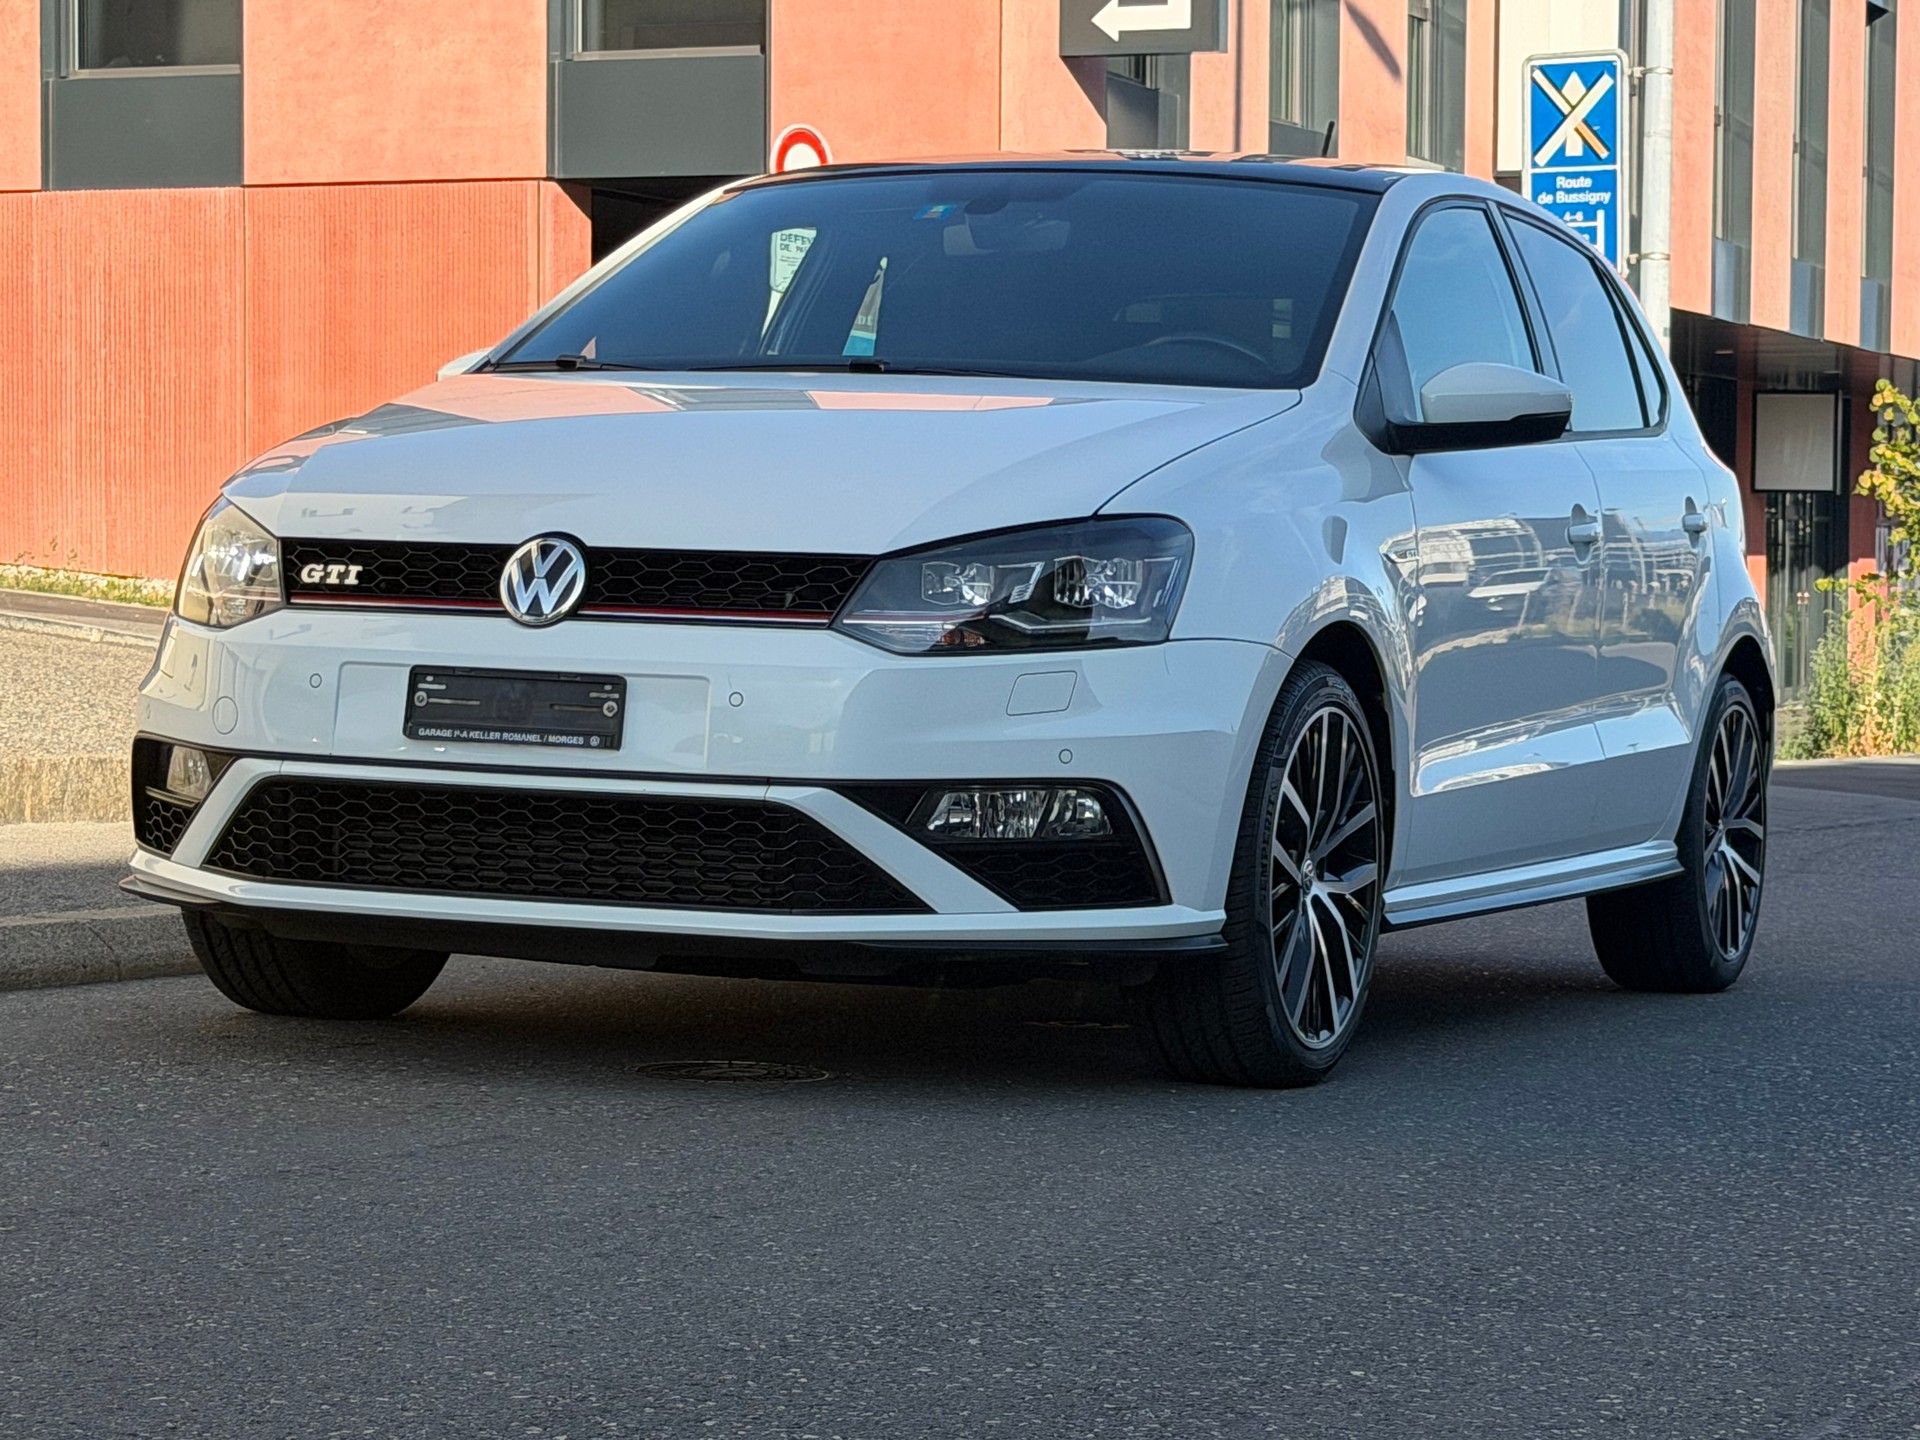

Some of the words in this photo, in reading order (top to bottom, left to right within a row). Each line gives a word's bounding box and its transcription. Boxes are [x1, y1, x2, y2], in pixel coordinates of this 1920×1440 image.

[1556, 176, 1592, 188] Route
[1537, 191, 1554, 205] de
[1556, 190, 1612, 205] Bussigny
[300, 564, 364, 586] GTI
[504, 539, 584, 620] VW
[418, 727, 453, 738] GARAGE
[468, 730, 501, 741] KELLER
[502, 732, 542, 743] ROMANEL
[548, 735, 584, 745] MORGES
